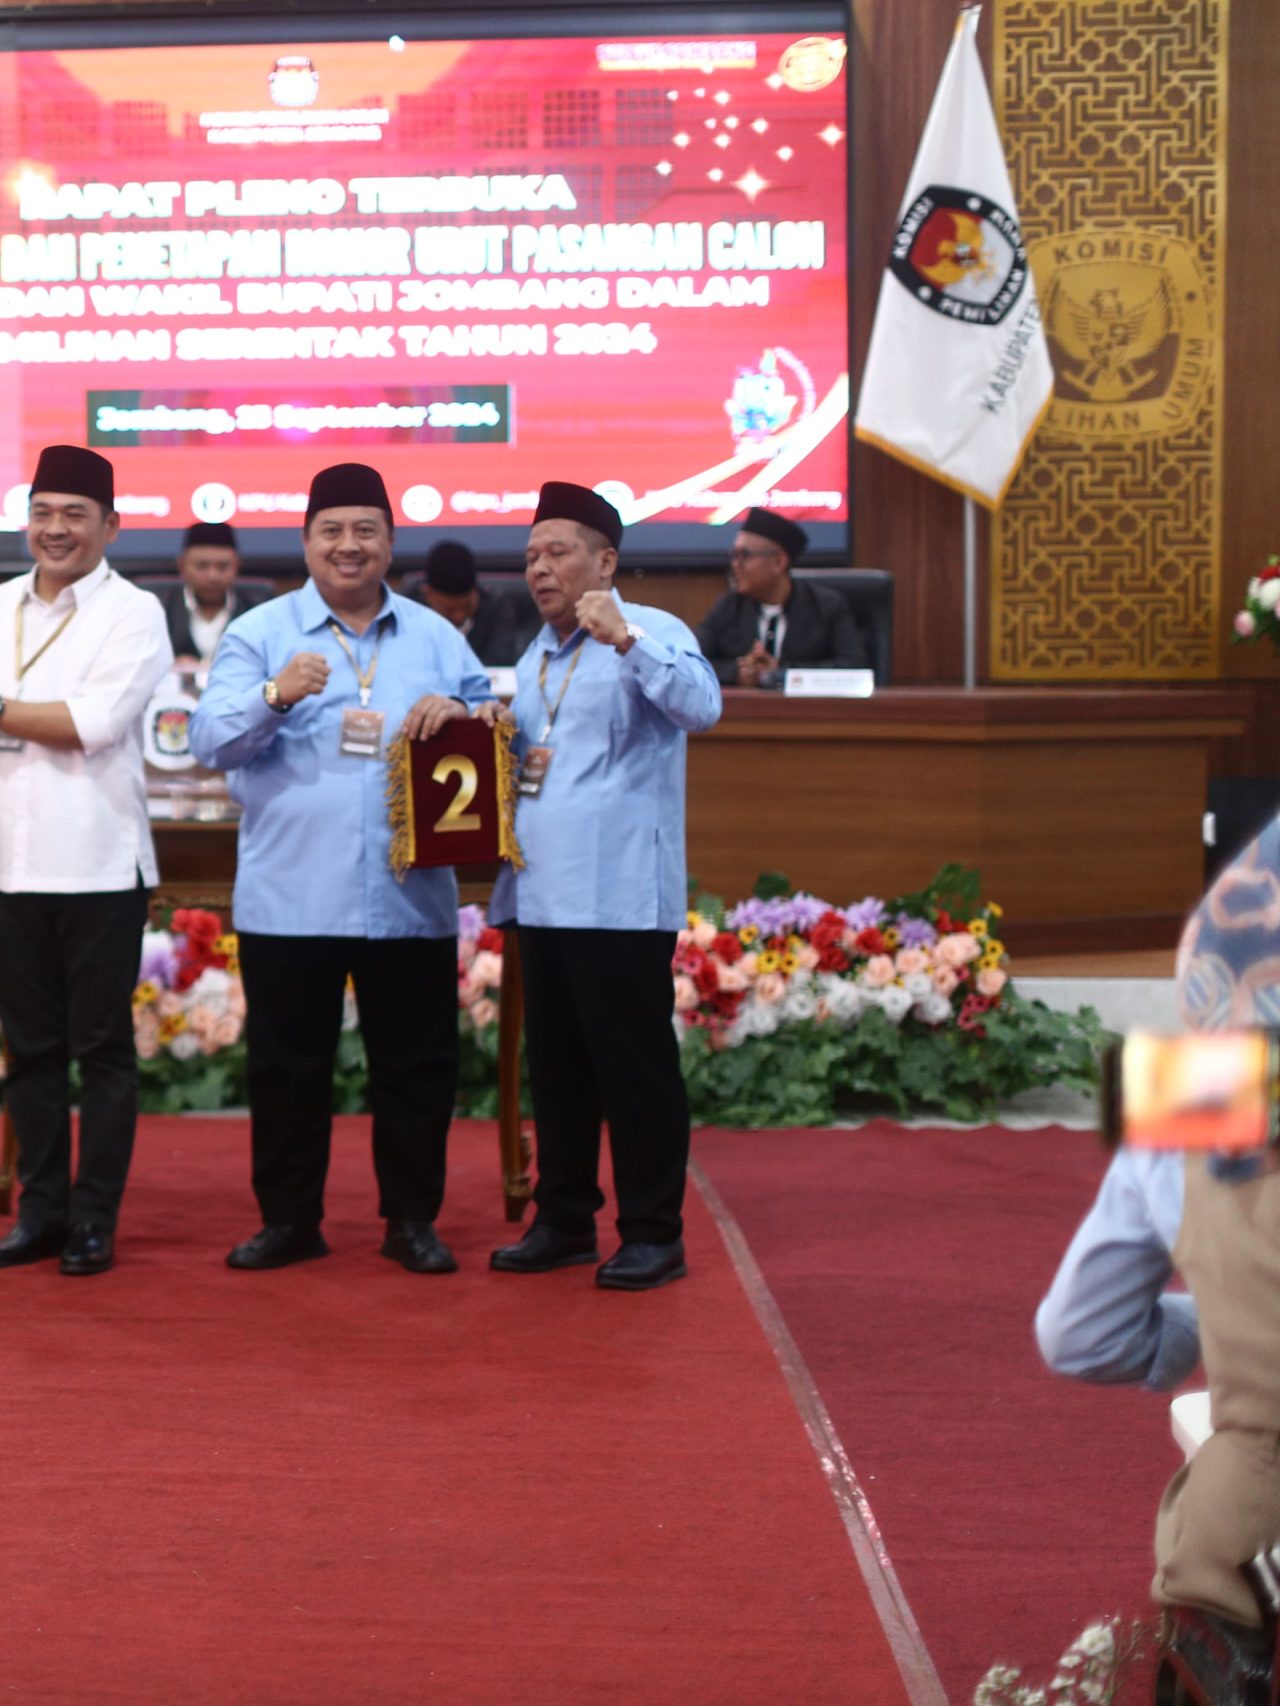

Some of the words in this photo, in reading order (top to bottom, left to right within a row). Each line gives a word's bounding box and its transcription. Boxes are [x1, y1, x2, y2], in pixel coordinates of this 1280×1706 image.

[893, 197, 935, 260] KOMISI
[1055, 240, 1169, 264] KOMISI
[238, 281, 393, 314] BUPATI
[617, 276, 769, 308] DALAM
[399, 325, 547, 357] TAHUN
[1162, 337, 1205, 420] UMUM
[431, 754, 481, 833] 2
